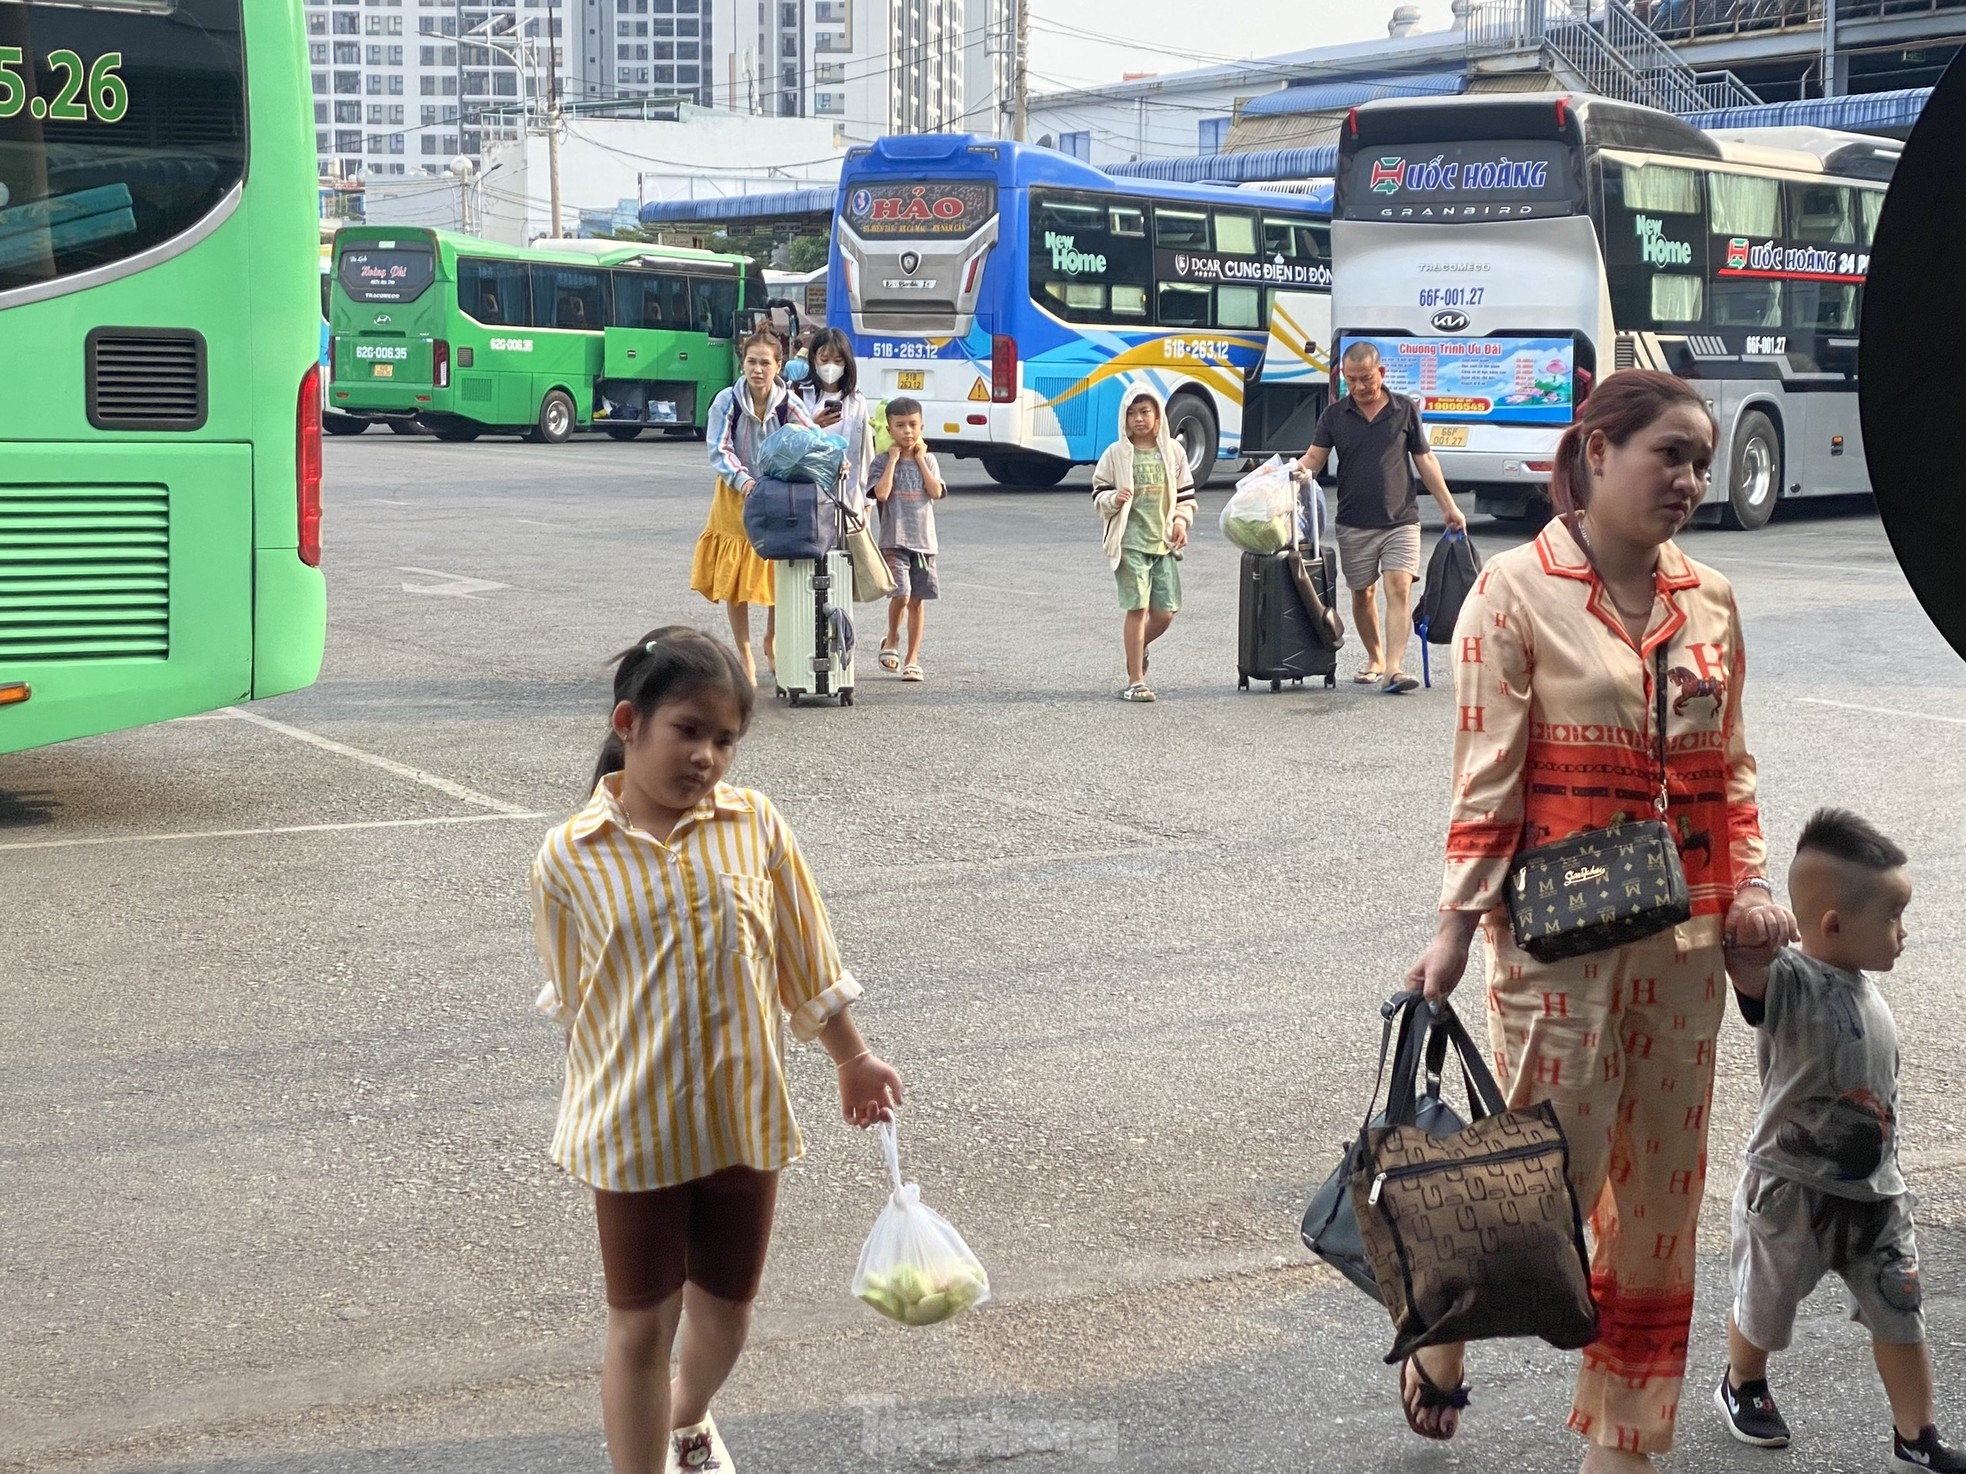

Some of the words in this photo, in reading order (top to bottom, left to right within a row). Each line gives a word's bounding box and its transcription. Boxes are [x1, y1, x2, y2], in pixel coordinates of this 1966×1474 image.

[1462, 157, 1548, 188] HOÀNG
[870, 186, 965, 220] HẢO
[1380, 206, 1532, 216] GRANBIRD
[1636, 214, 1663, 236] New
[1044, 231, 1075, 249] New
[1052, 246, 1107, 275] Home
[1643, 234, 1692, 269] Home
[1784, 246, 1837, 273] HOÀNG
[1839, 252, 1855, 274] 34
[1191, 258, 1220, 271] DCAR
[1224, 260, 1261, 278] CUNG
[1295, 266, 1307, 282] DI
[1418, 263, 1491, 272] TRACOMECO
[1419, 287, 1485, 307] 66F-001.27
[356, 346, 407, 359] 62G-006.35
[490, 338, 534, 352] 62G-006.35
[1164, 339, 1229, 360] 51B-263.12
[1746, 336, 1787, 355] 66F-001.27
[1427, 402, 1486, 411] 19006545
[1441, 427, 1458, 436] 66F
